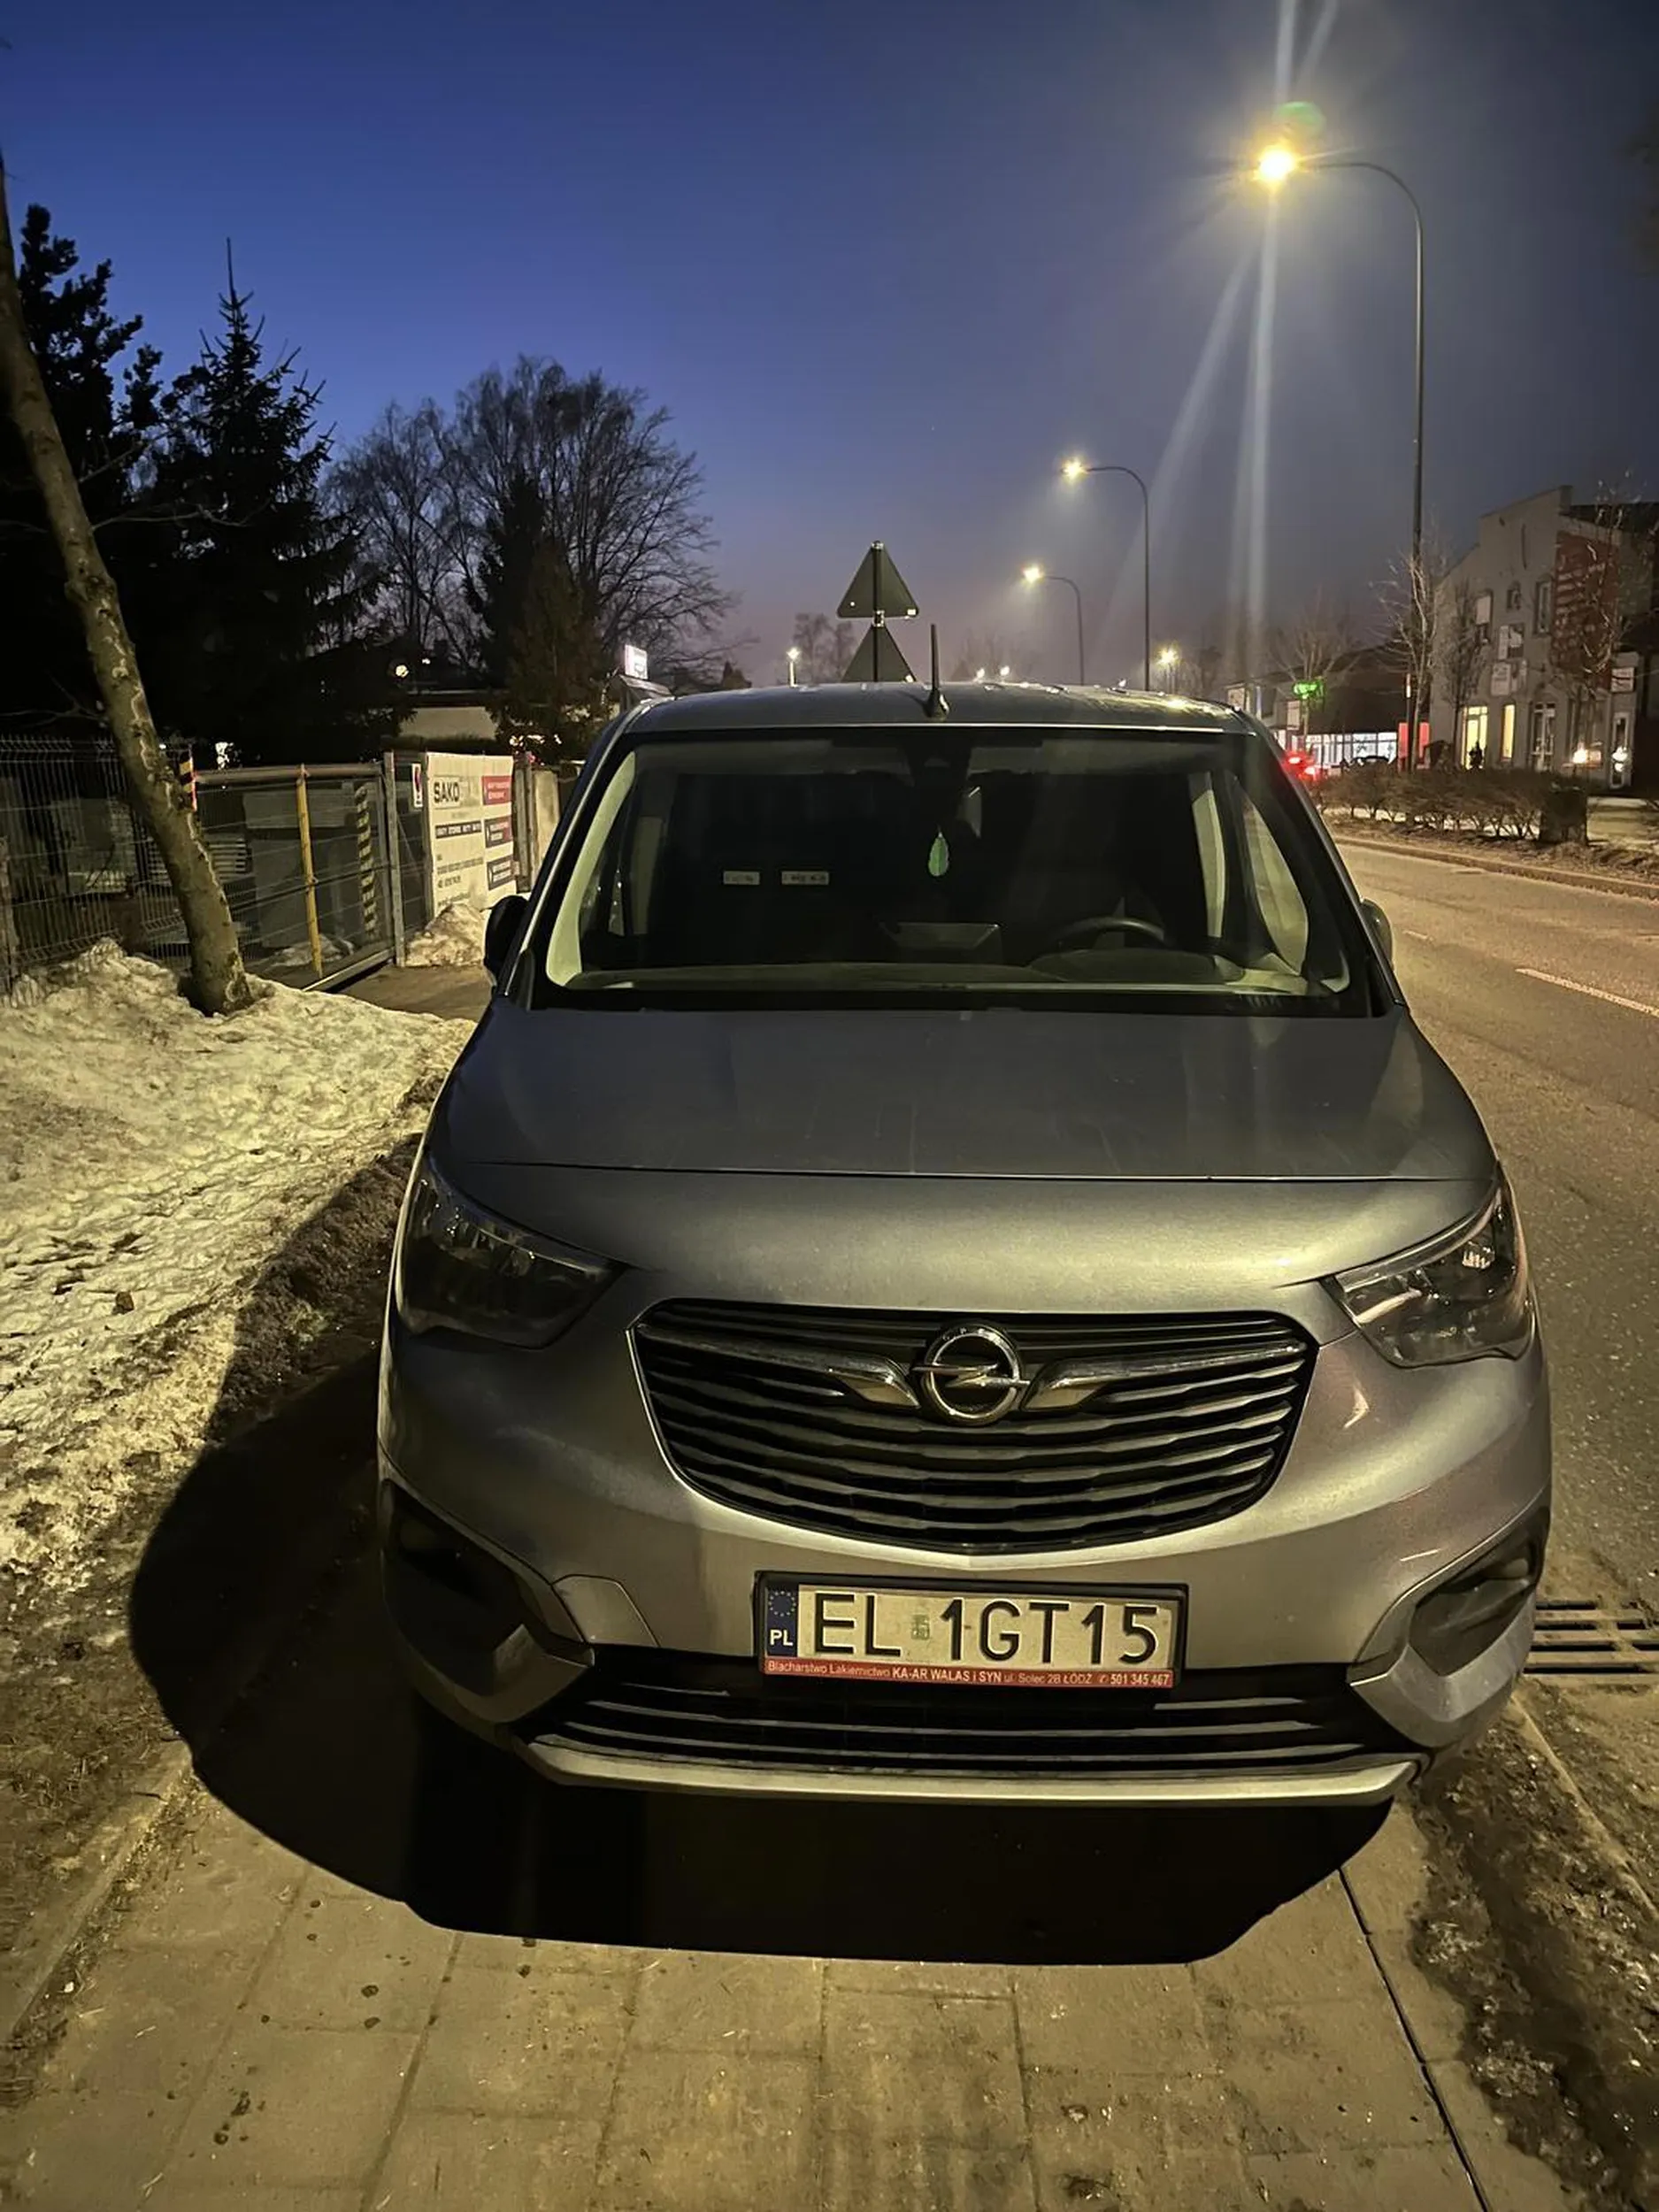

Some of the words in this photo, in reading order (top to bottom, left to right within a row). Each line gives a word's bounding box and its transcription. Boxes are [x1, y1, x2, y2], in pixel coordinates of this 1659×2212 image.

[769, 1629, 794, 1647] PL
[815, 1593, 902, 1657] EL
[940, 1599, 1158, 1665] 1GT15
[931, 1669, 971, 1682] WALAS
[979, 1671, 1002, 1683] SYN
[1110, 1673, 1128, 1685] 501
